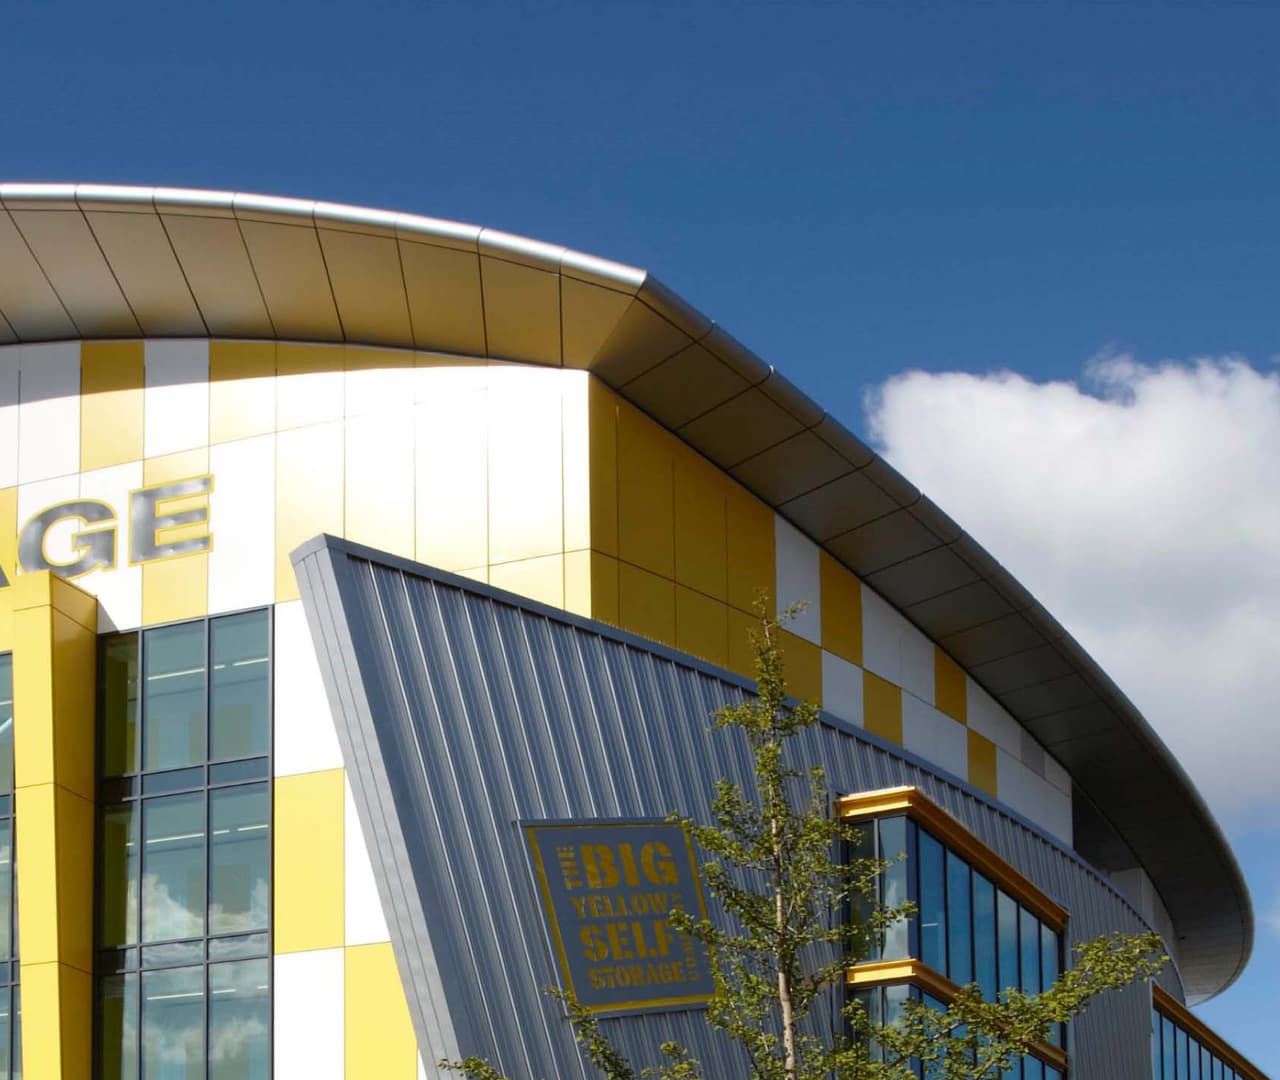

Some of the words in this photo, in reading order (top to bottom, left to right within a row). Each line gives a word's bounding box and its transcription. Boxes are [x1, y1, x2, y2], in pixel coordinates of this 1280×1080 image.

[580, 841, 679, 889] BIG
[572, 892, 670, 918] YELLOW
[580, 919, 675, 962] SELF
[588, 961, 686, 990] STORAGE
